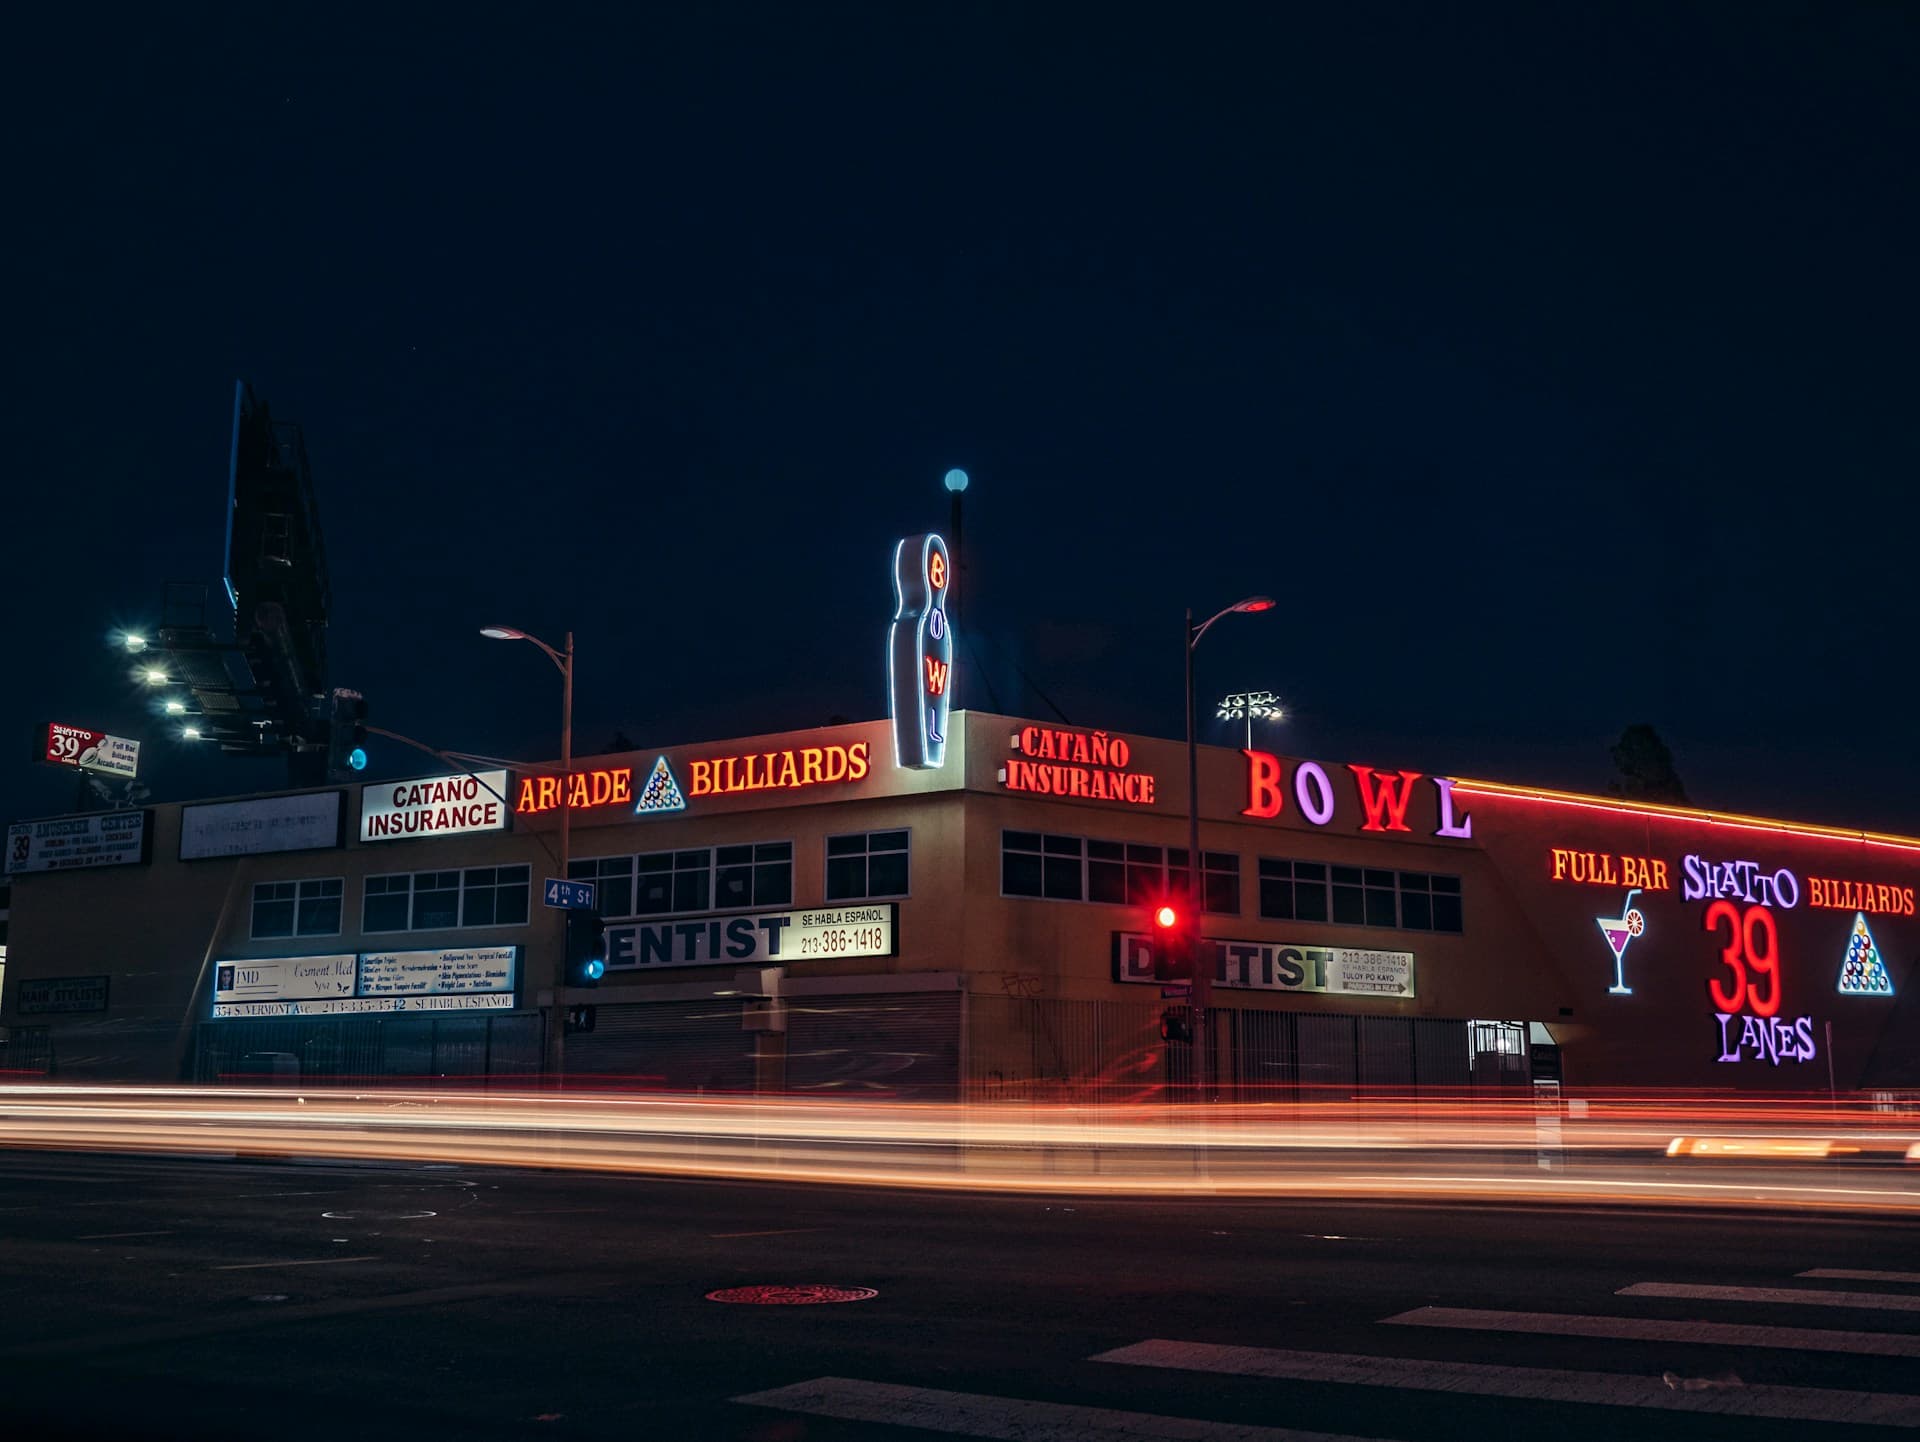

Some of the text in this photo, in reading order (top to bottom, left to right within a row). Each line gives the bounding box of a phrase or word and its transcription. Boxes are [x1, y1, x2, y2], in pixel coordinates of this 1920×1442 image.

[925, 552, 948, 743] BOWL
[50, 734, 80, 758] 39
[53, 725, 92, 741] SHATTO
[1021, 726, 1130, 768] CATAÑO
[689, 742, 871, 797] BILLIARDS
[1005, 759, 1155, 804] INSURANCE
[392, 776, 478, 808] CATAÑO
[1241, 748, 1472, 839] BOWL
[368, 802, 498, 837] INSURANCE
[1552, 848, 1670, 890] FULL BAR
[1682, 854, 1800, 910] SHATTO
[548, 883, 591, 905] 4th St
[1807, 876, 1915, 916] BILLIARDS
[802, 908, 884, 926] SE HABLA ESPAÑOL
[608, 916, 791, 966] ENTIST
[1703, 899, 1782, 1018] 39
[1128, 937, 1333, 988] DTIST
[1343, 972, 1363, 980] TULOY
[245, 1003, 291, 1015] VERMONT
[430, 998, 462, 1009] HABLA
[1715, 1012, 1817, 1067] LANES
